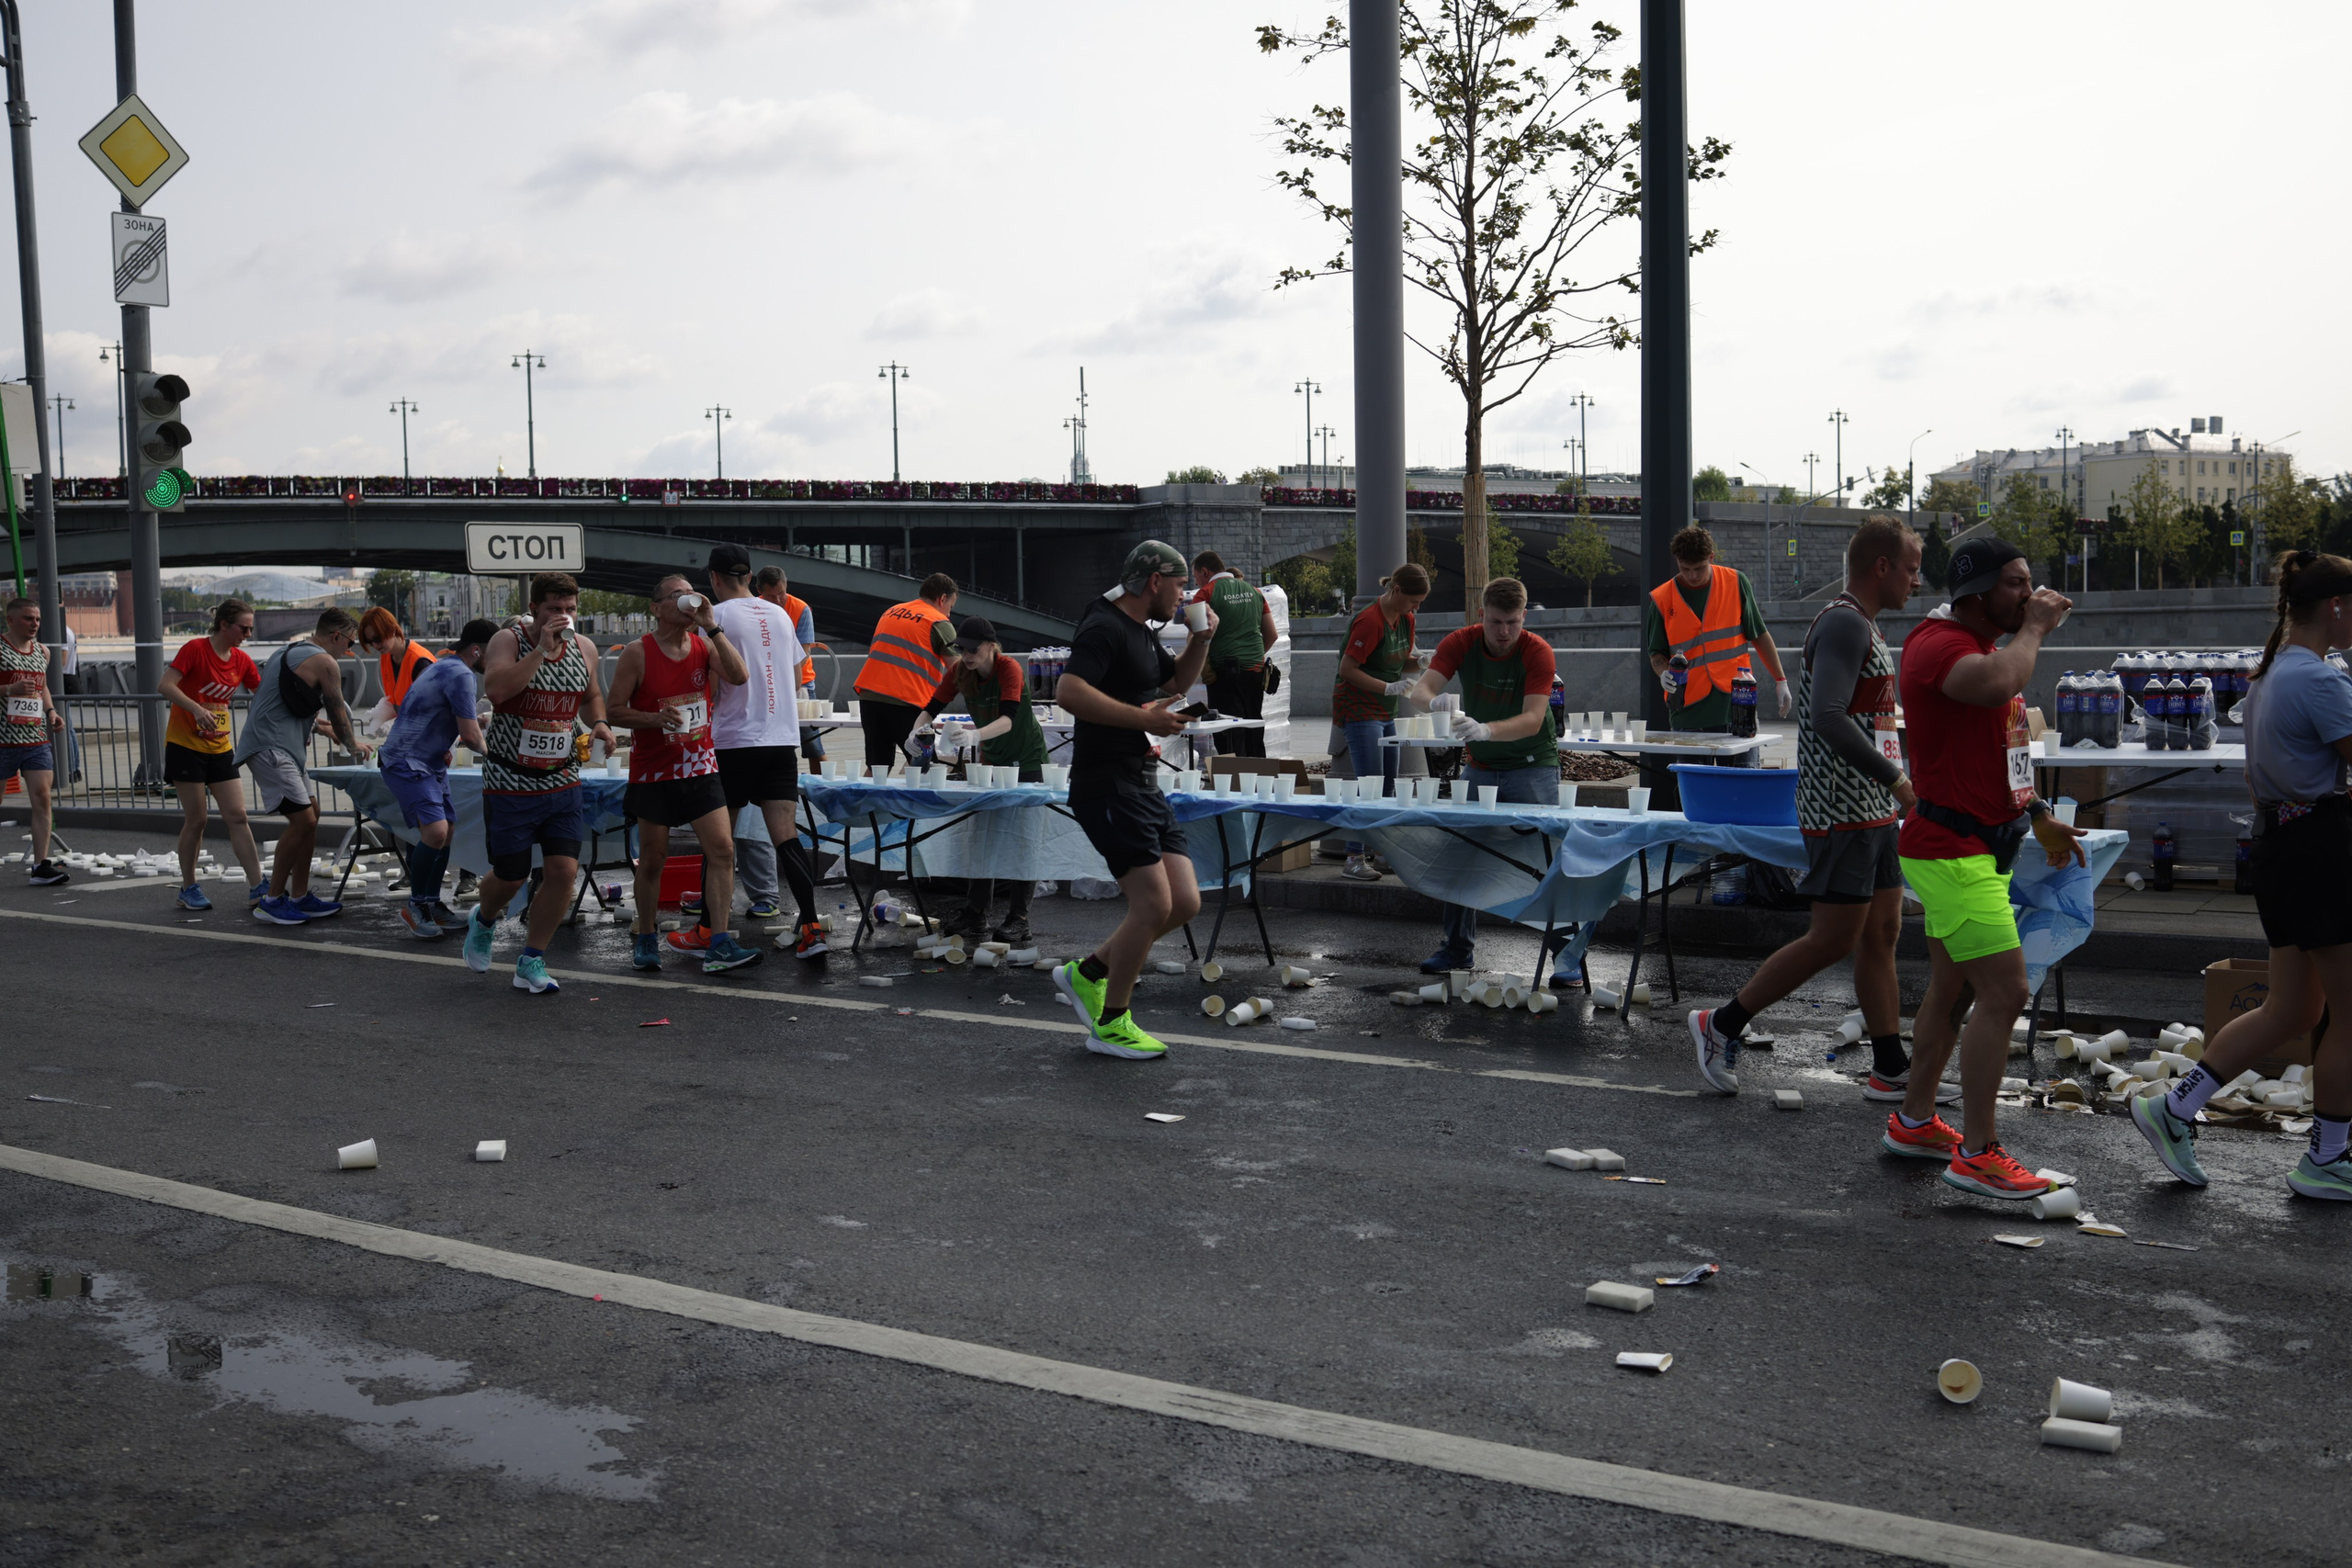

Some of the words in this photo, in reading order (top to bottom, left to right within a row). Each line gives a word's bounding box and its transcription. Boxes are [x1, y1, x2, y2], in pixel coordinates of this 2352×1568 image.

[124, 219, 154, 232] ЗОНА
[488, 535, 564, 559] СТОП
[883, 607, 924, 623] УДЬЯ
[758, 618, 771, 647] ВДНХ
[765, 664, 775, 715] ЛОНГРАН
[14, 700, 39, 712] 7363
[519, 692, 577, 713] ЛУЖНИКИ
[216, 714, 226, 725] 75
[528, 735, 565, 751] 5518
[669, 734, 675, 742] E
[522, 757, 529, 765] E
[2173, 1069, 2205, 1102] SAYSKY
[2310, 1120, 2322, 1155] SAYSKY
